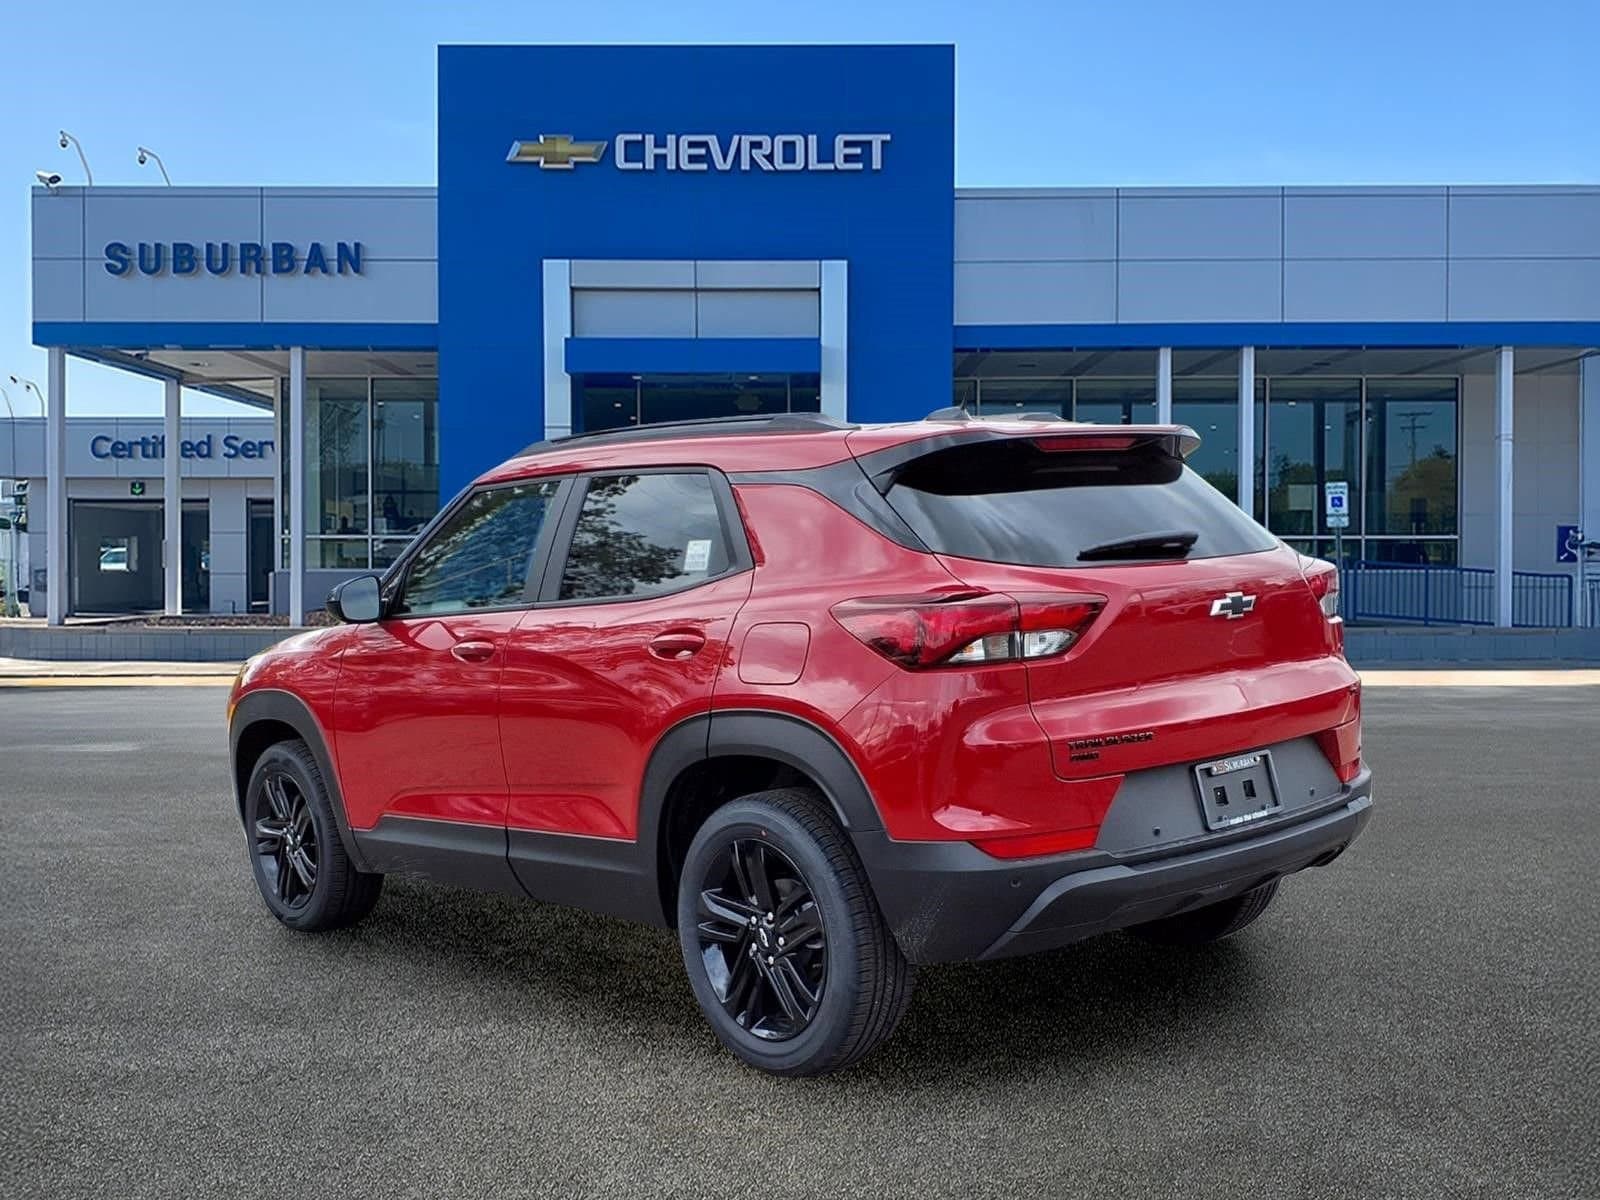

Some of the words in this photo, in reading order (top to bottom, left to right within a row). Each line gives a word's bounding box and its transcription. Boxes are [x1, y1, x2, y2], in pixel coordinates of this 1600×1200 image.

[615, 134, 891, 170] CHEVROLET
[104, 242, 361, 276] SUBURBAN
[91, 434, 212, 459] Certifed
